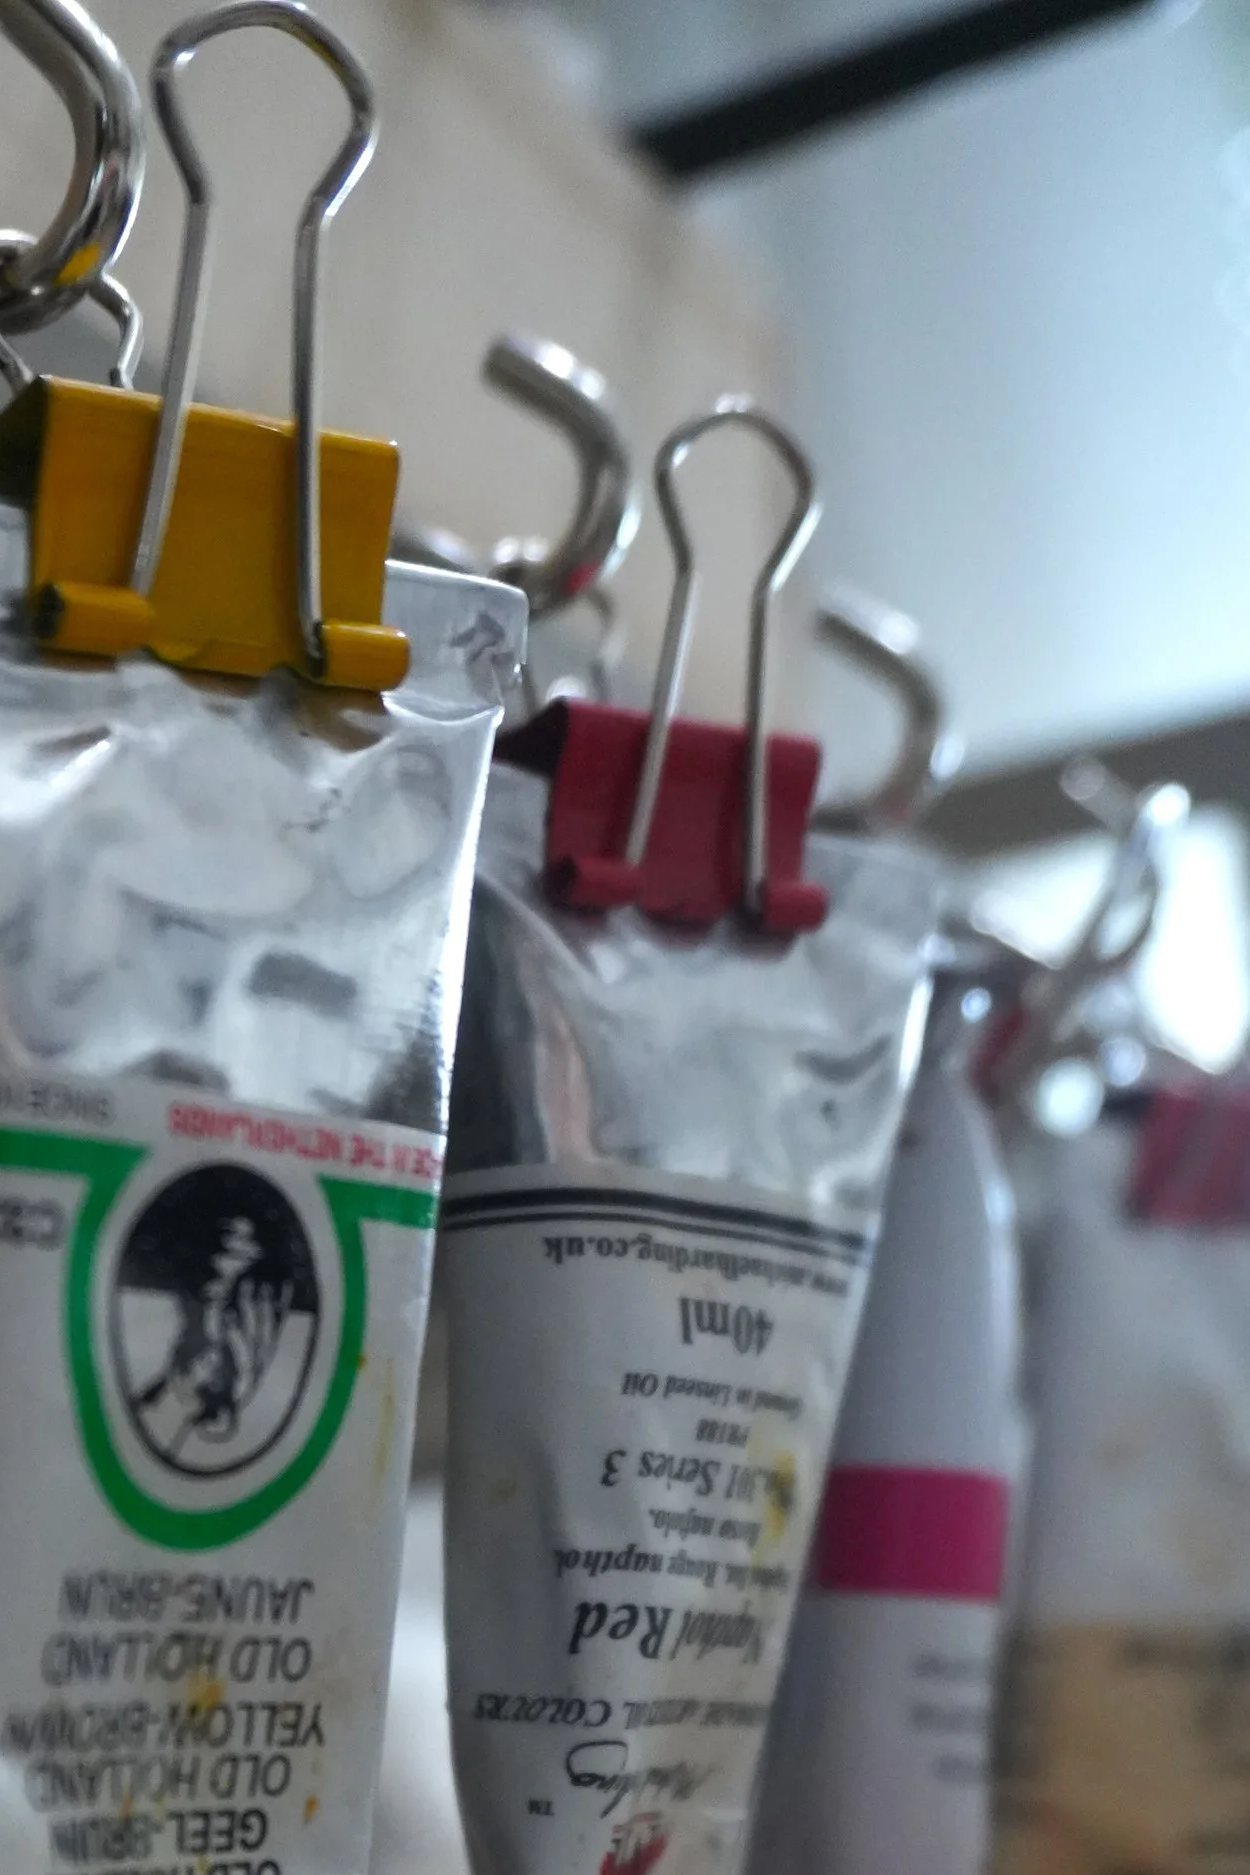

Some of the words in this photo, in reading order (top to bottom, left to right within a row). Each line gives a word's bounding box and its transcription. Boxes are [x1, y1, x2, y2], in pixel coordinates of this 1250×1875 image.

[678, 1296, 774, 1356] 40ml
[621, 1372, 658, 1397] Oil
[663, 1374, 733, 1408] Linseed
[599, 1450, 627, 1488] 3
[637, 1451, 720, 1498] Series
[567, 1602, 673, 1660] Red
[40, 1631, 222, 1688] HOLLAND
[230, 1637, 312, 1683] OLD
[474, 1692, 612, 1730] COLOURS
[23, 1756, 200, 1813] HOLLAND
[209, 1753, 291, 1800] OLD
